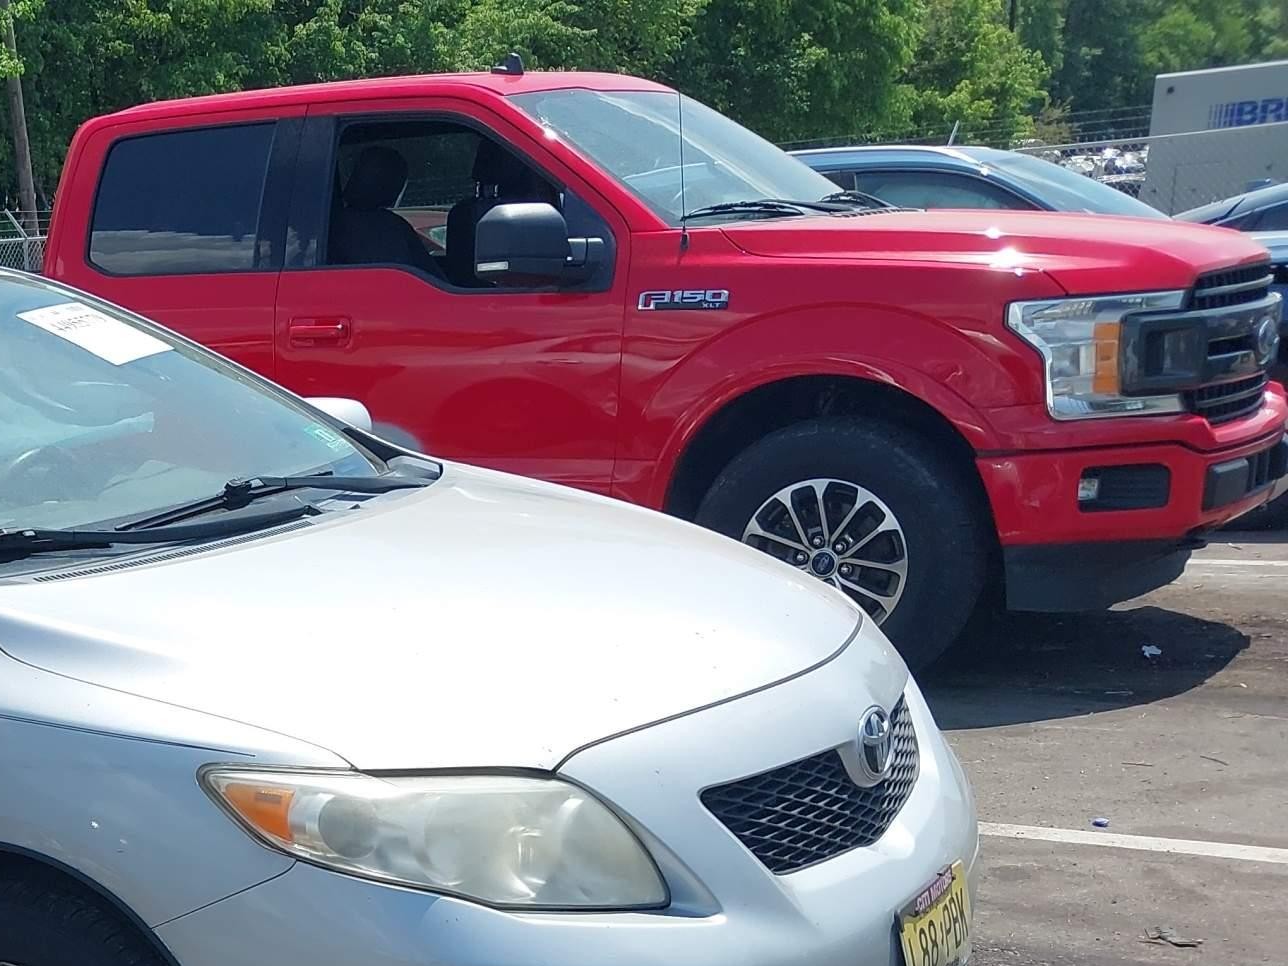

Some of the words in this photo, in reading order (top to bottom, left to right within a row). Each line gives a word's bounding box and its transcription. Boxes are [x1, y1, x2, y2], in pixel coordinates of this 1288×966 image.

[1234, 97, 1288, 126] BR
[637, 289, 729, 310] F150
[942, 887, 969, 958] PBK
